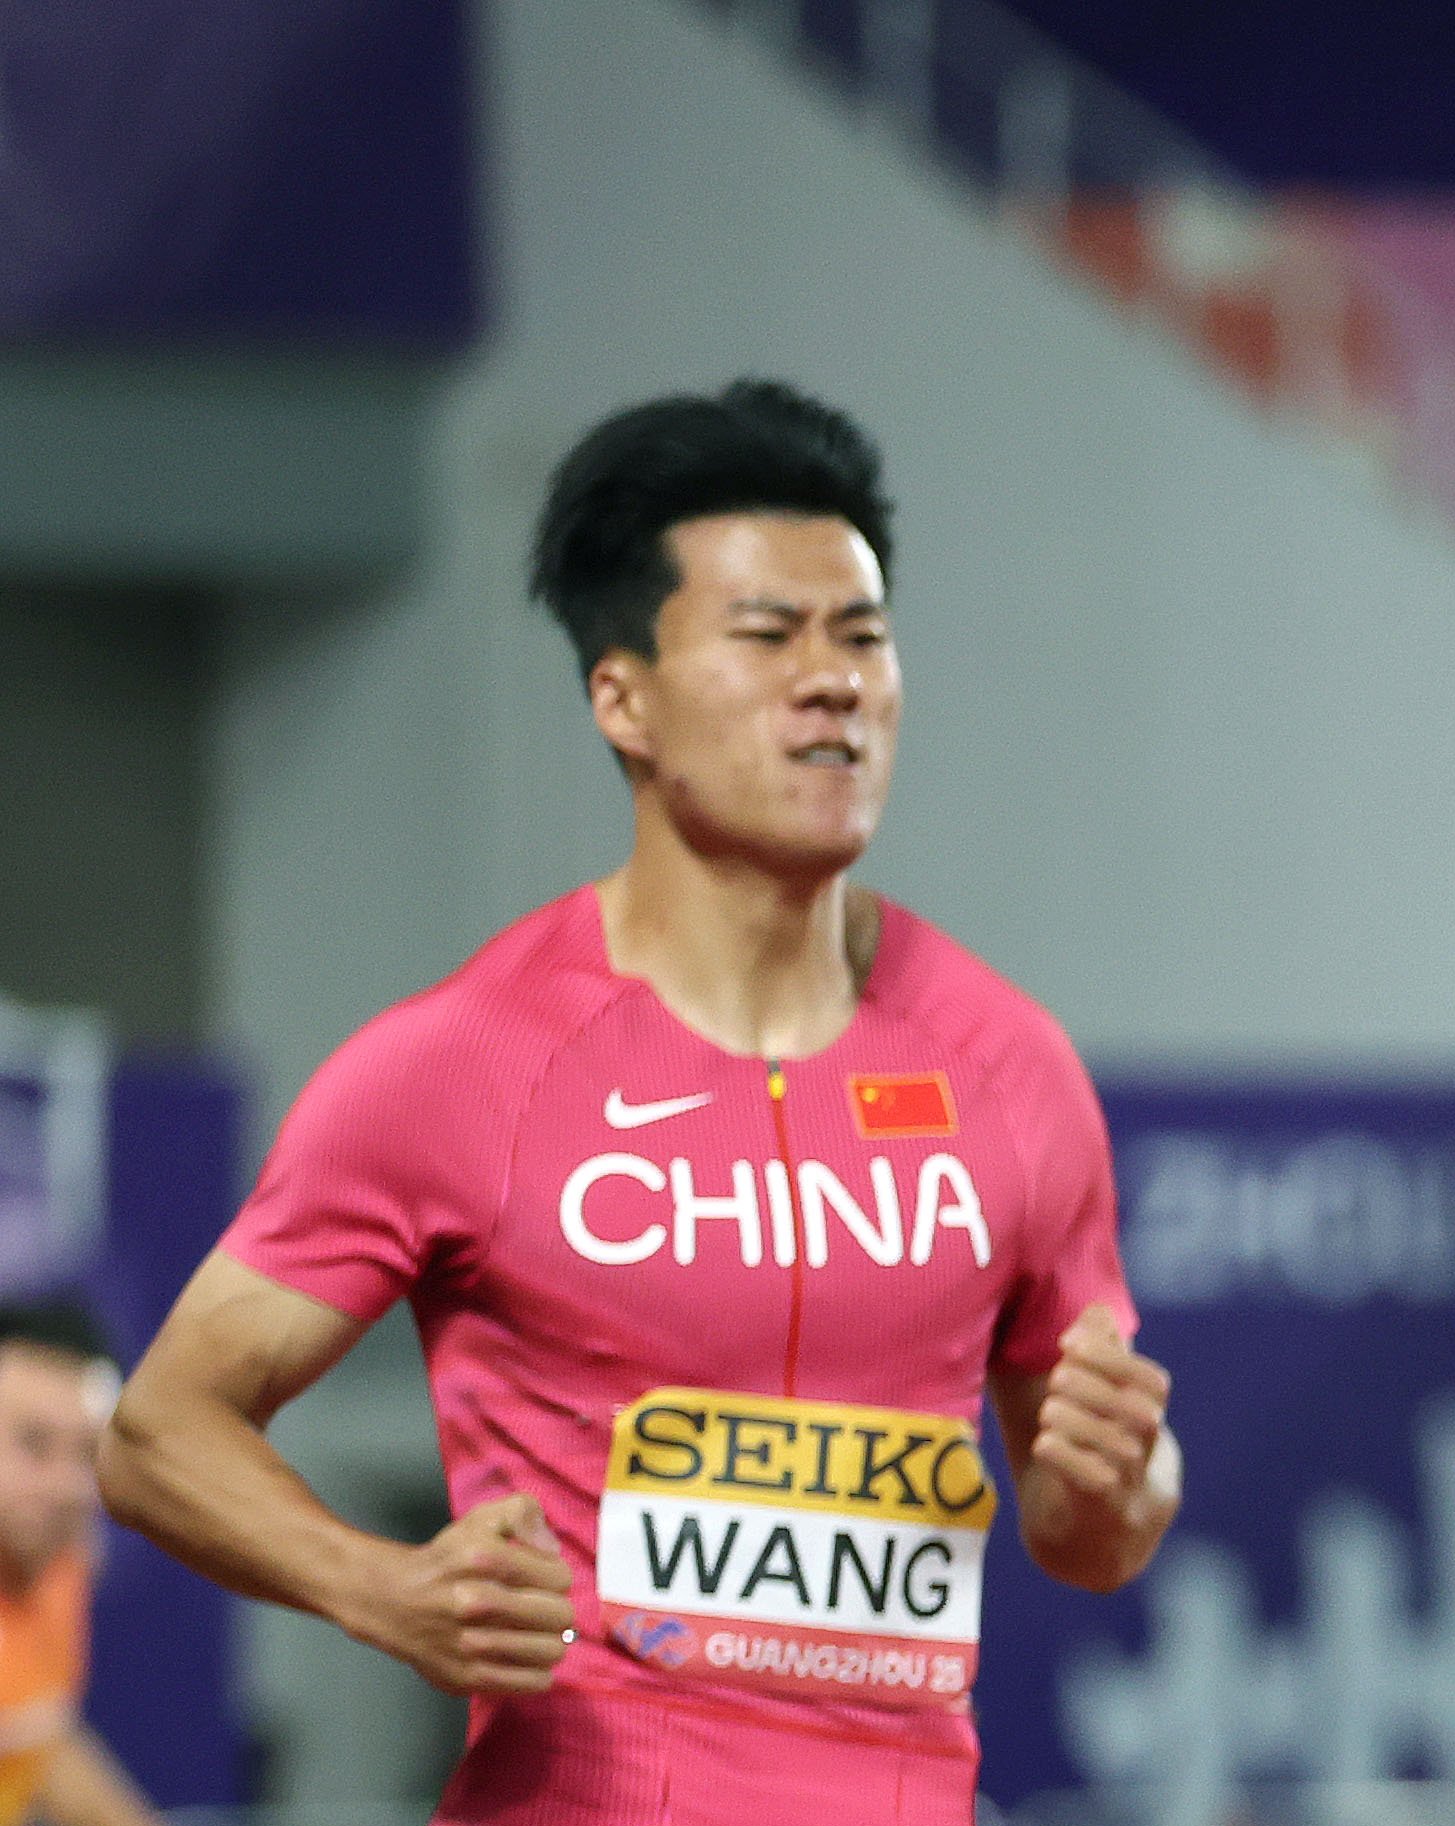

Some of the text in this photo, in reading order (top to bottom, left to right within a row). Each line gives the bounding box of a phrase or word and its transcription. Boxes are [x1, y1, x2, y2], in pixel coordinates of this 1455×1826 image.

[560, 1152, 992, 1267] CHINA
[628, 1406, 985, 1511] SEIKO
[642, 1511, 952, 1618] WANG
[704, 1632, 927, 1691] GUANGZHOU
